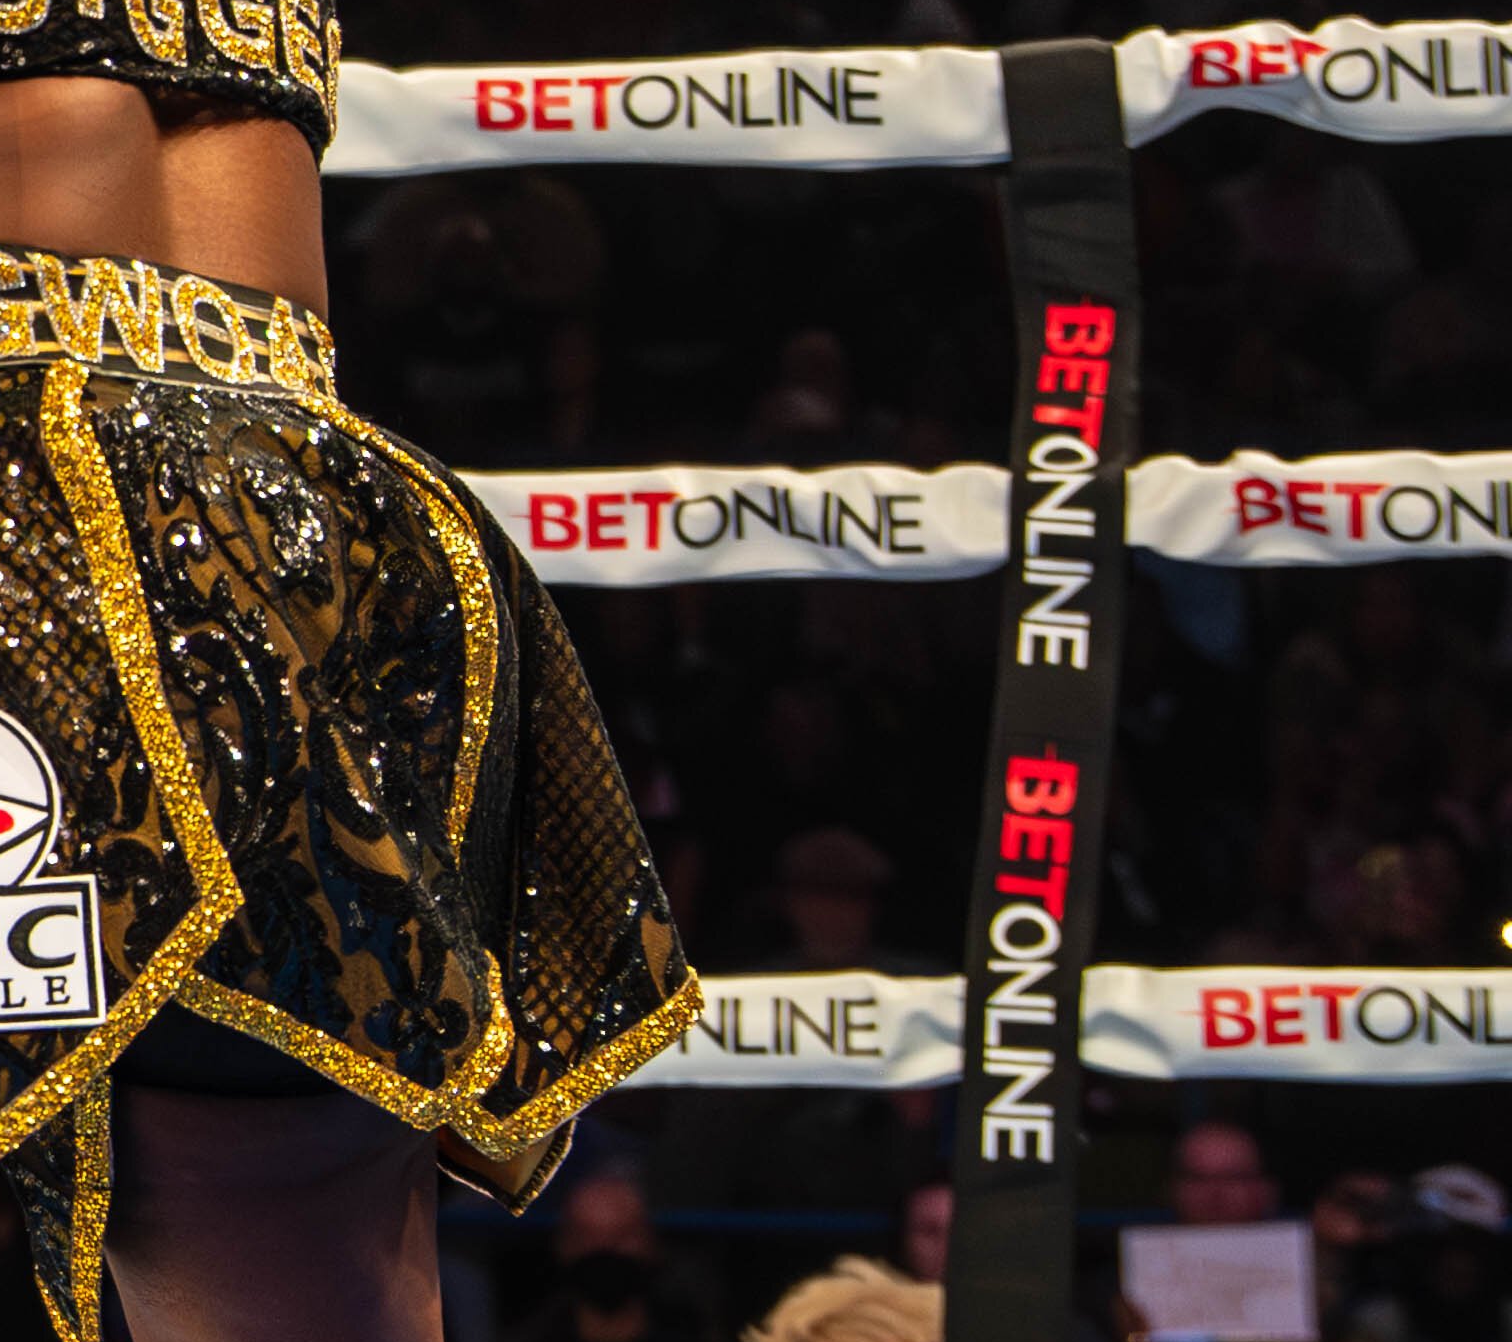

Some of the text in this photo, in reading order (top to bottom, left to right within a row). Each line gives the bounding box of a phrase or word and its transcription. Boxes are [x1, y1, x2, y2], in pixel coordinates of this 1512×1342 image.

[466, 66, 883, 133] BETONLINE
[522, 491, 927, 556] BETONLINE
[1017, 297, 1117, 673] BETONLINE
[981, 751, 1080, 1165] BETONLINE
